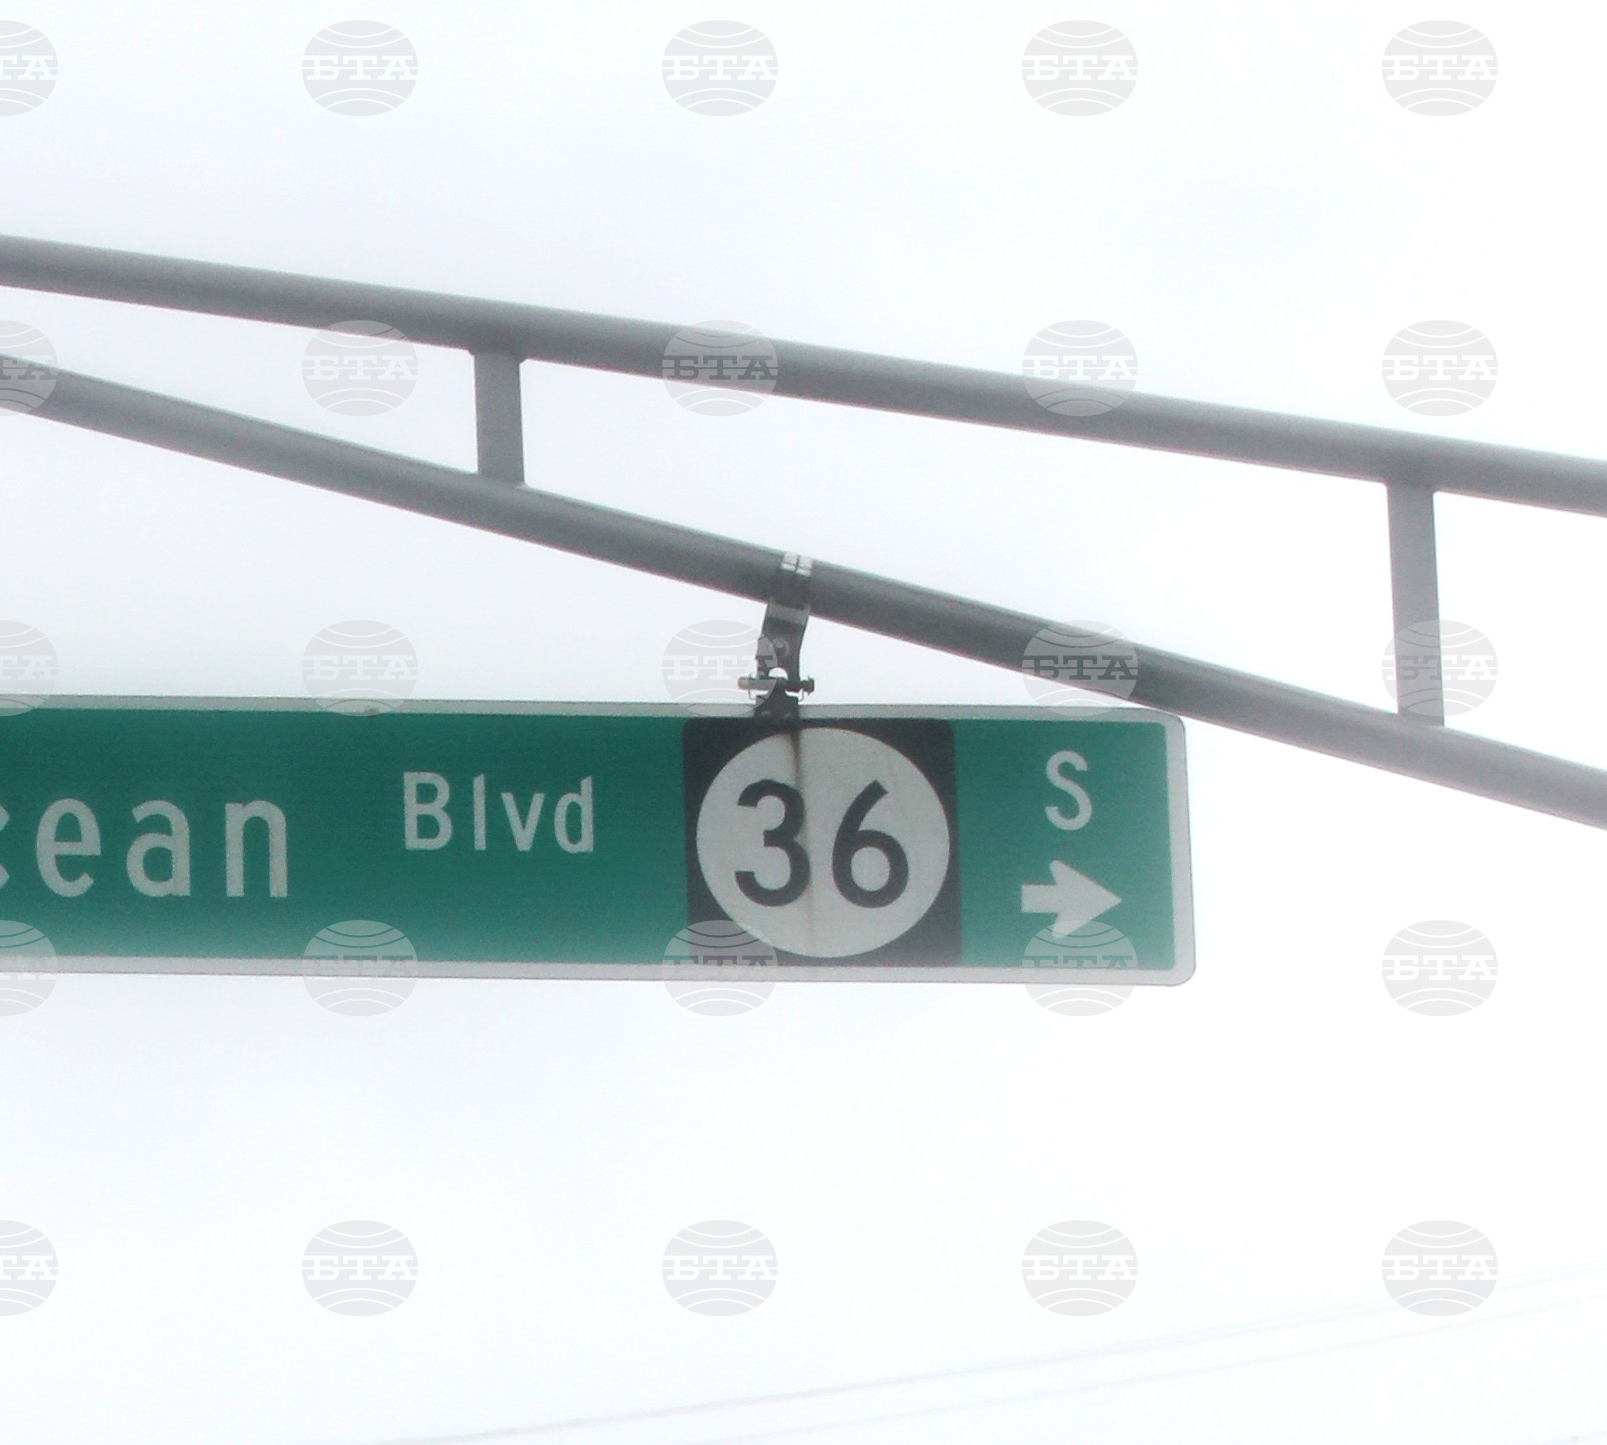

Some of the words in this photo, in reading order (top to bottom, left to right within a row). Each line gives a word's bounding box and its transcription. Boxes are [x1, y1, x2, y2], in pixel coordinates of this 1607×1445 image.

[403, 772, 595, 853] Blvd
[1045, 755, 1093, 832] S
[733, 776, 911, 908] 36
